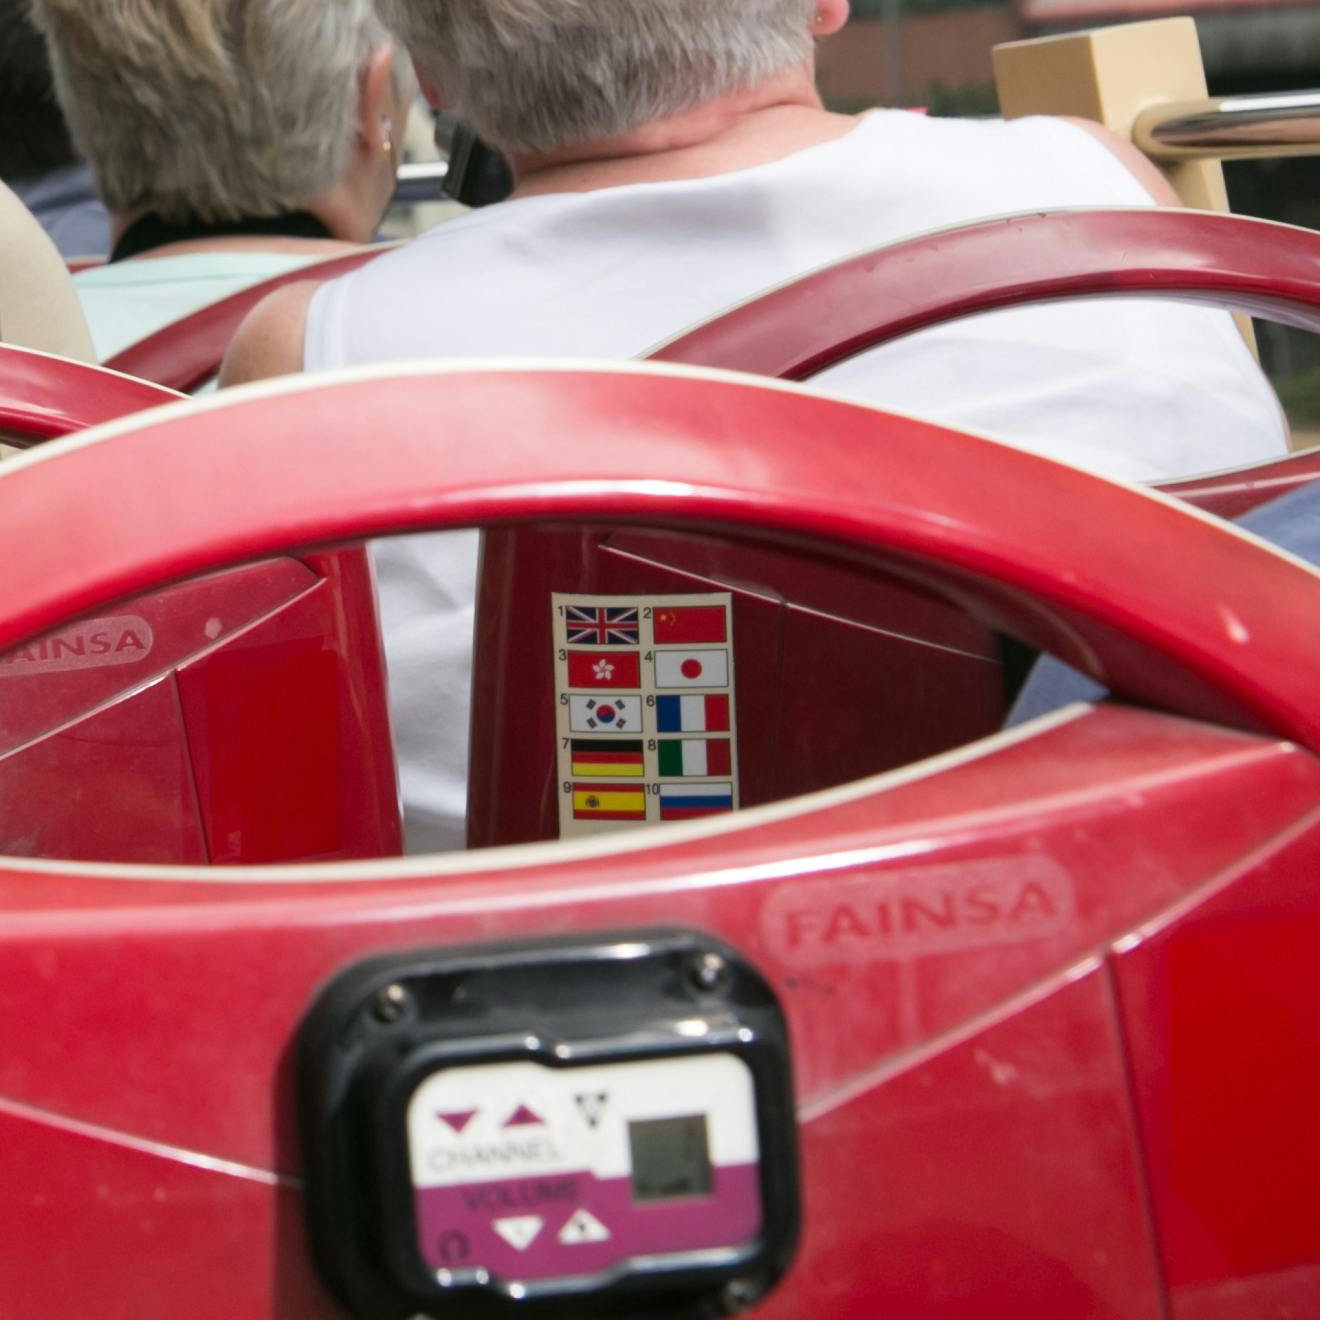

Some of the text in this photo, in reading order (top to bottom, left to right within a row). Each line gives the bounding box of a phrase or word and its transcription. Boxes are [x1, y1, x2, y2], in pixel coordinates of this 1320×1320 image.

[558, 606, 564, 617] 1
[643, 607, 652, 619] 2
[559, 649, 567, 661] 3
[644, 650, 653, 662] 4
[560, 693, 568, 705] 5
[646, 694, 655, 706] 6
[562, 738, 570, 750] 7
[648, 739, 656, 751] 8
[563, 782, 571, 794] 9
[647, 783, 659, 795] 10
[785, 881, 1055, 948] FAINSA
[428, 1138, 563, 1172] CHANNEL
